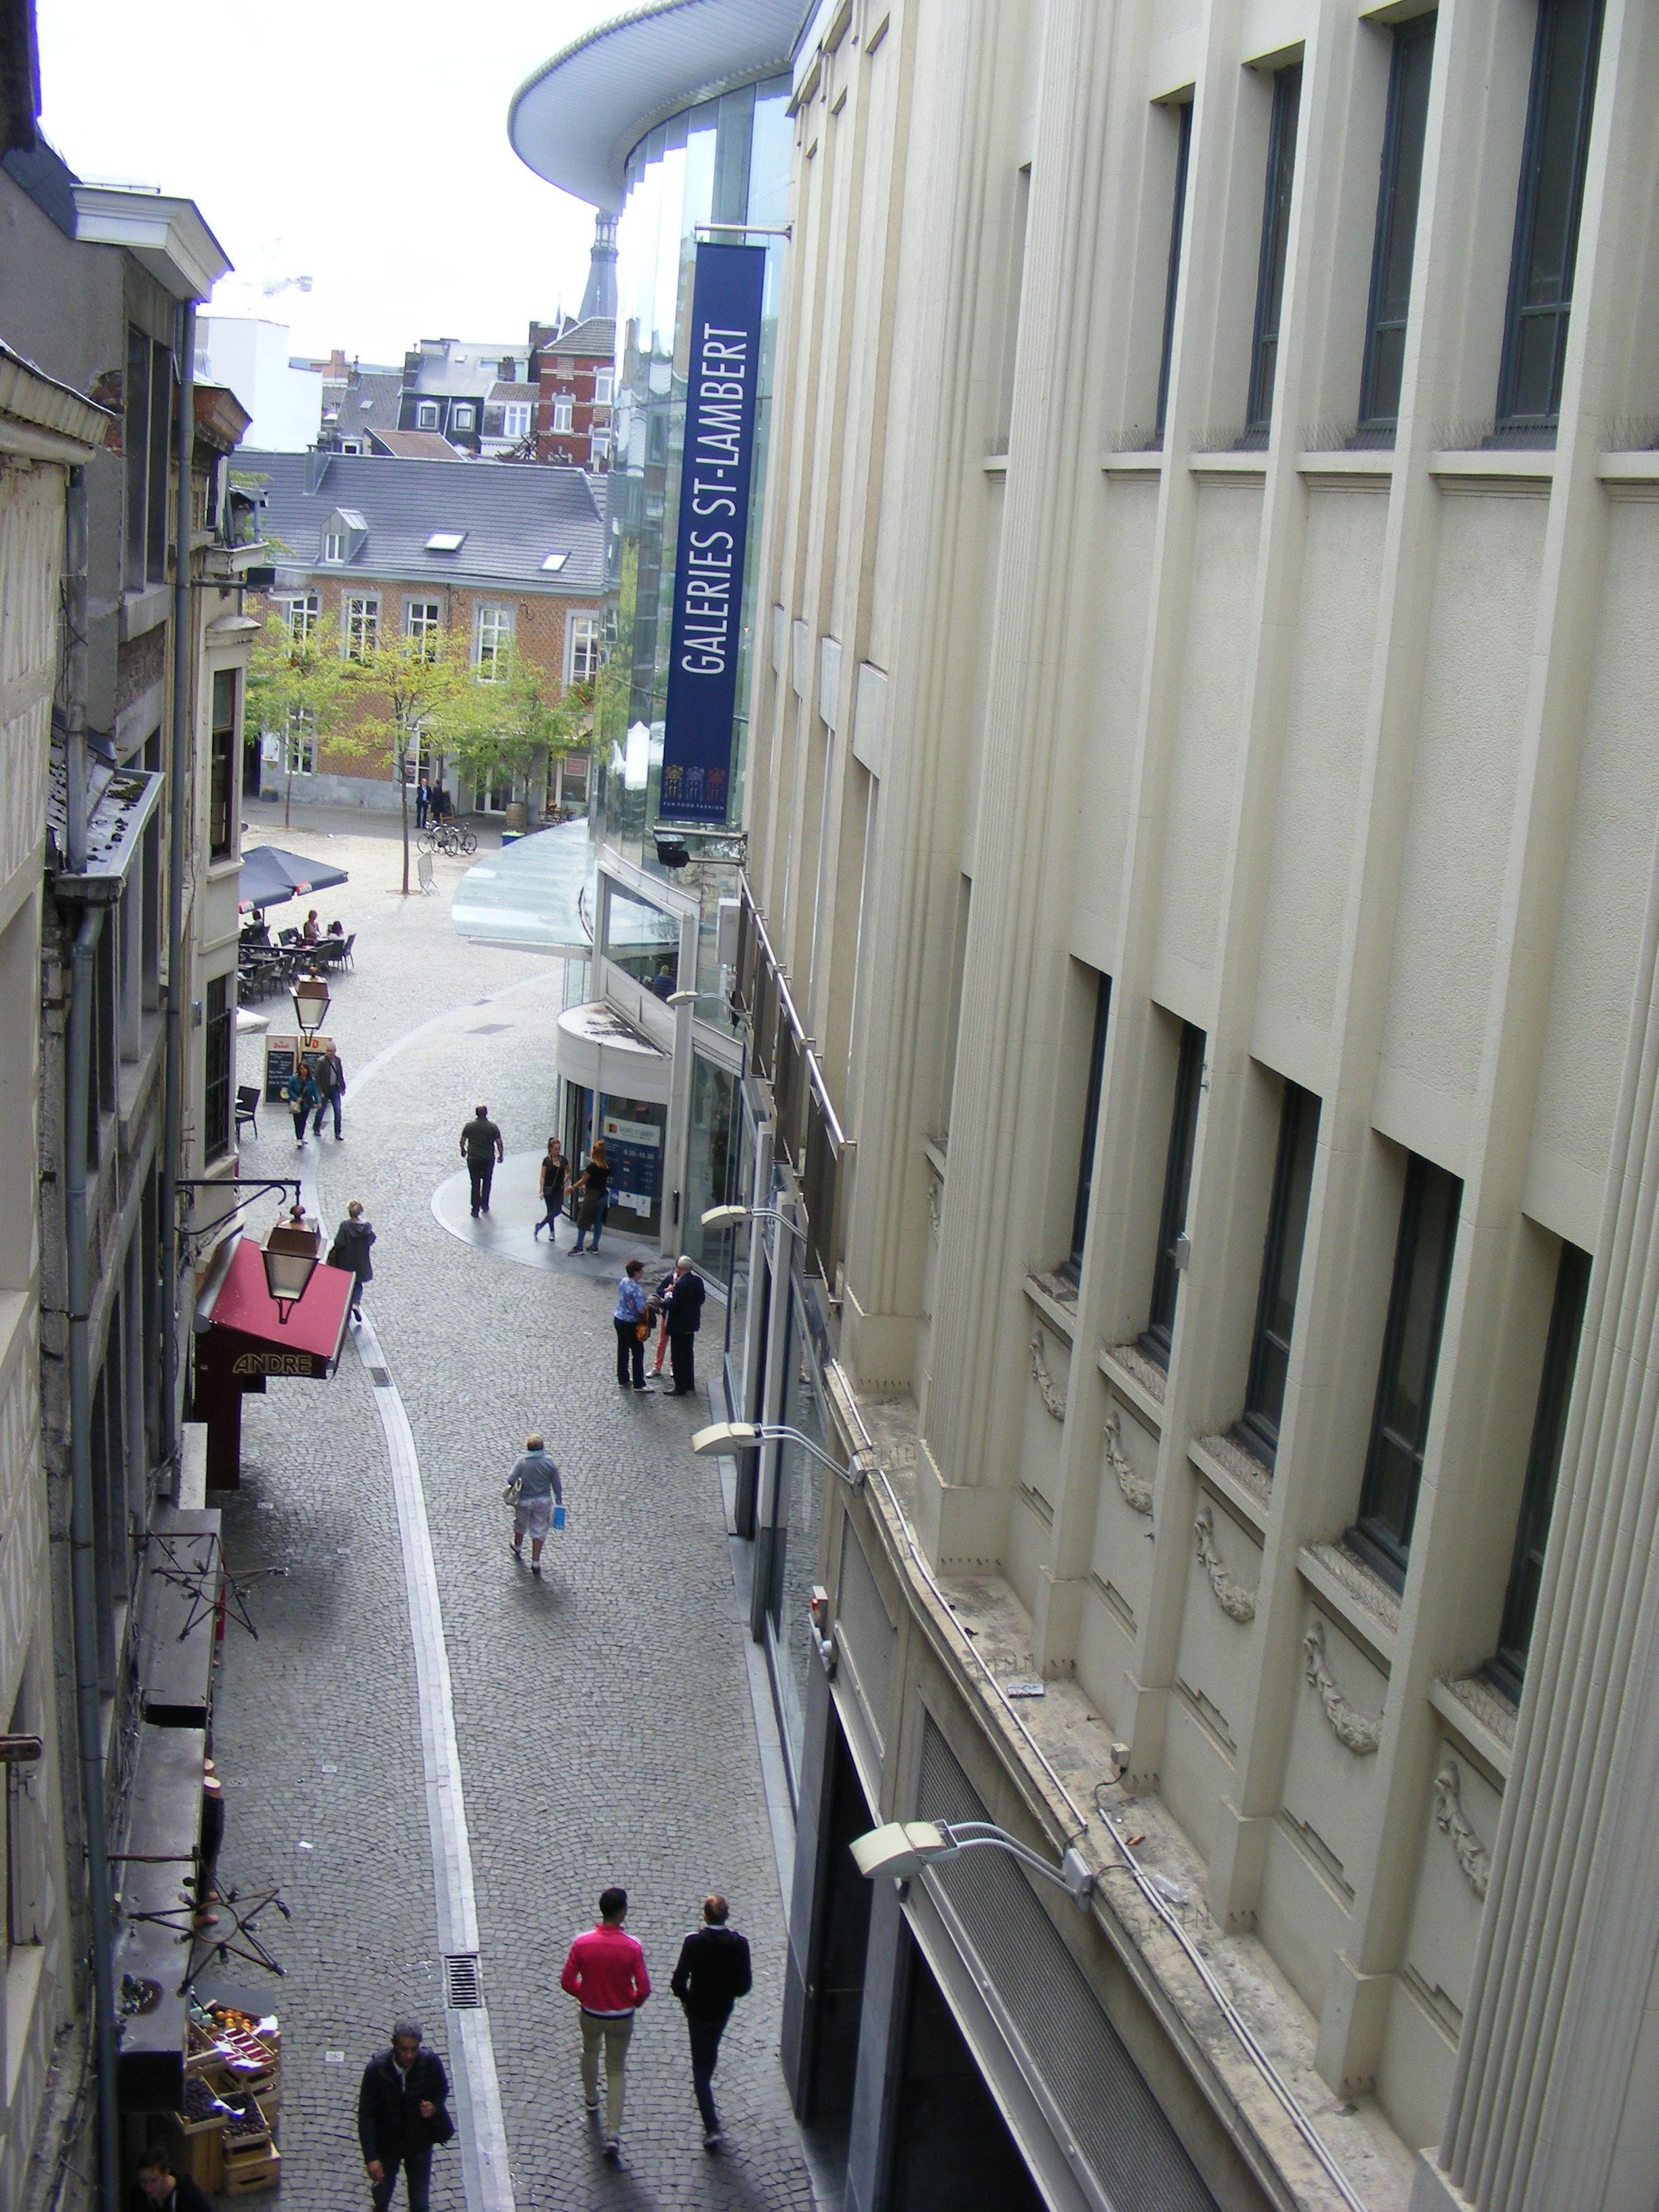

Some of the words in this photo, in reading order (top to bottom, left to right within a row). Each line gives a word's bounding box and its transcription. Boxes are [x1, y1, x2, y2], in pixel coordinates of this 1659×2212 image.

[692, 323, 749, 517] ST-LAMBERT
[681, 531, 734, 675] GALERIES
[232, 1353, 312, 1374] ANDRE
